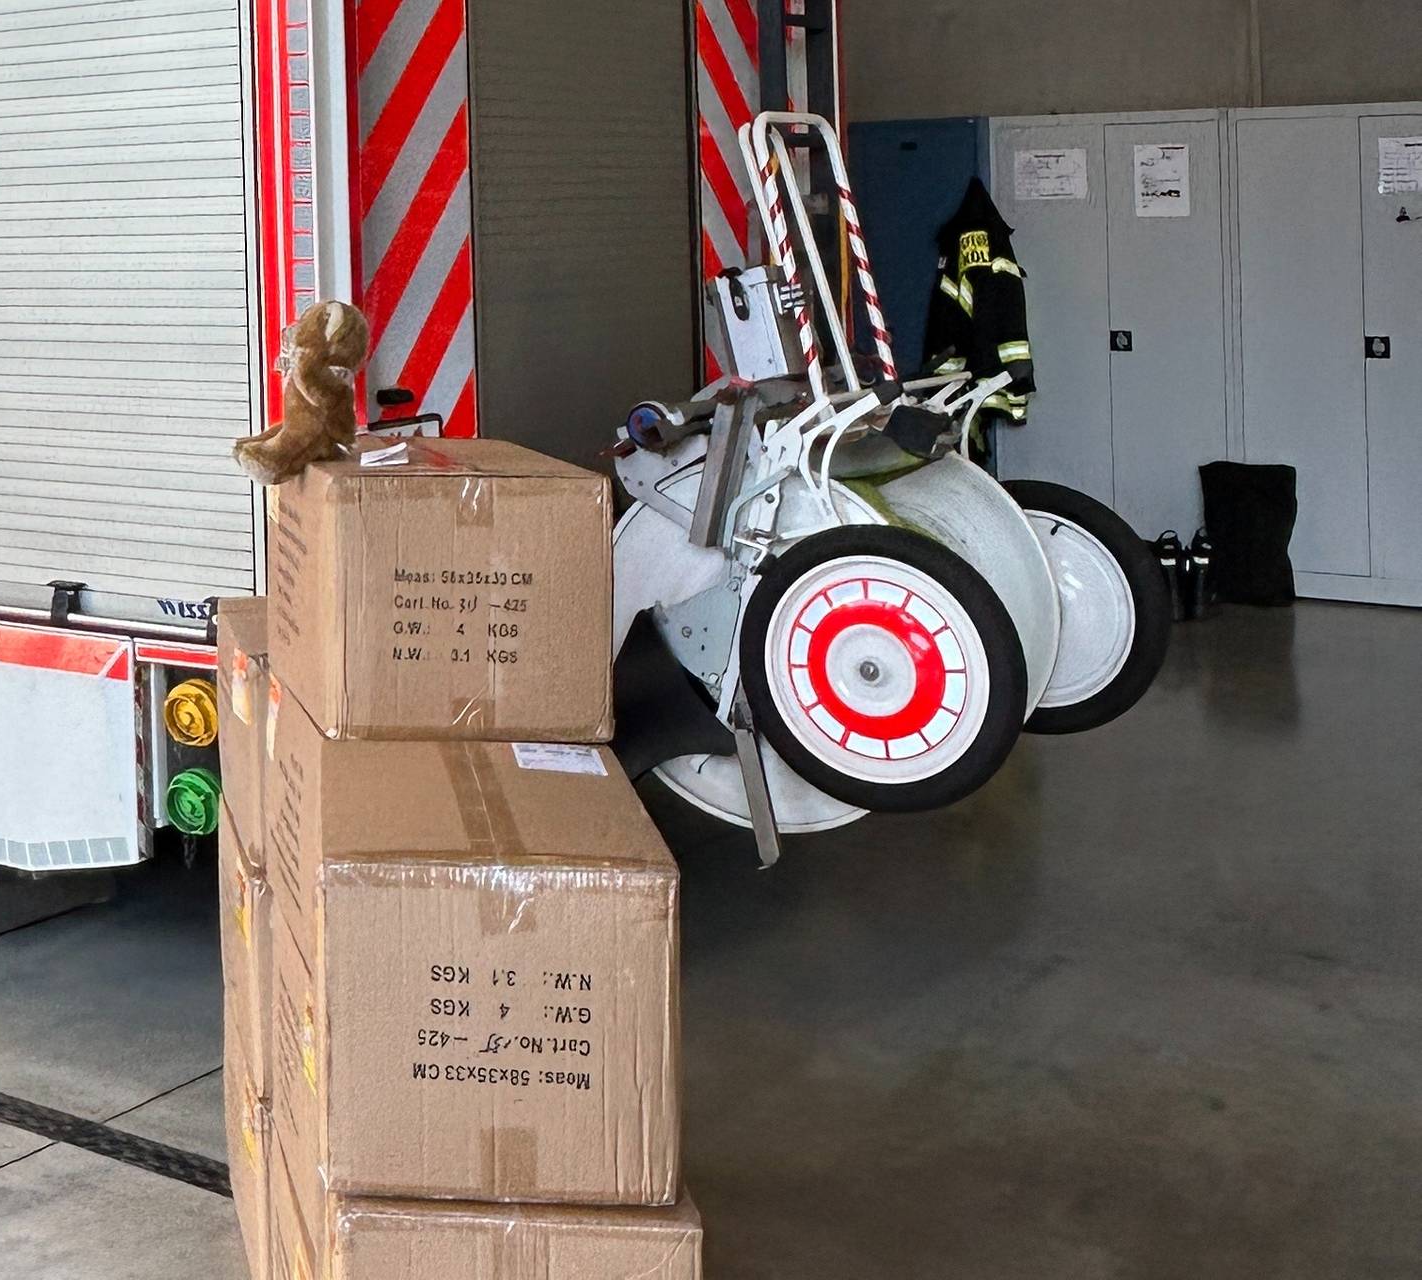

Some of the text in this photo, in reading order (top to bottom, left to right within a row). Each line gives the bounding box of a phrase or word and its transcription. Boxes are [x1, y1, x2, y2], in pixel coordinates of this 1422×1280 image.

[456, 623, 465, 635] 4
[488, 623, 519, 638] KGS
[486, 649, 518, 664] KGS
[430, 964, 470, 984] KGS
[492, 968, 516, 987] 3.1
[430, 998, 470, 1017] KGS
[499, 1003, 511, 1019] 4
[412, 1063, 440, 1080] CM
[445, 1065, 531, 1087] 58x35x33
